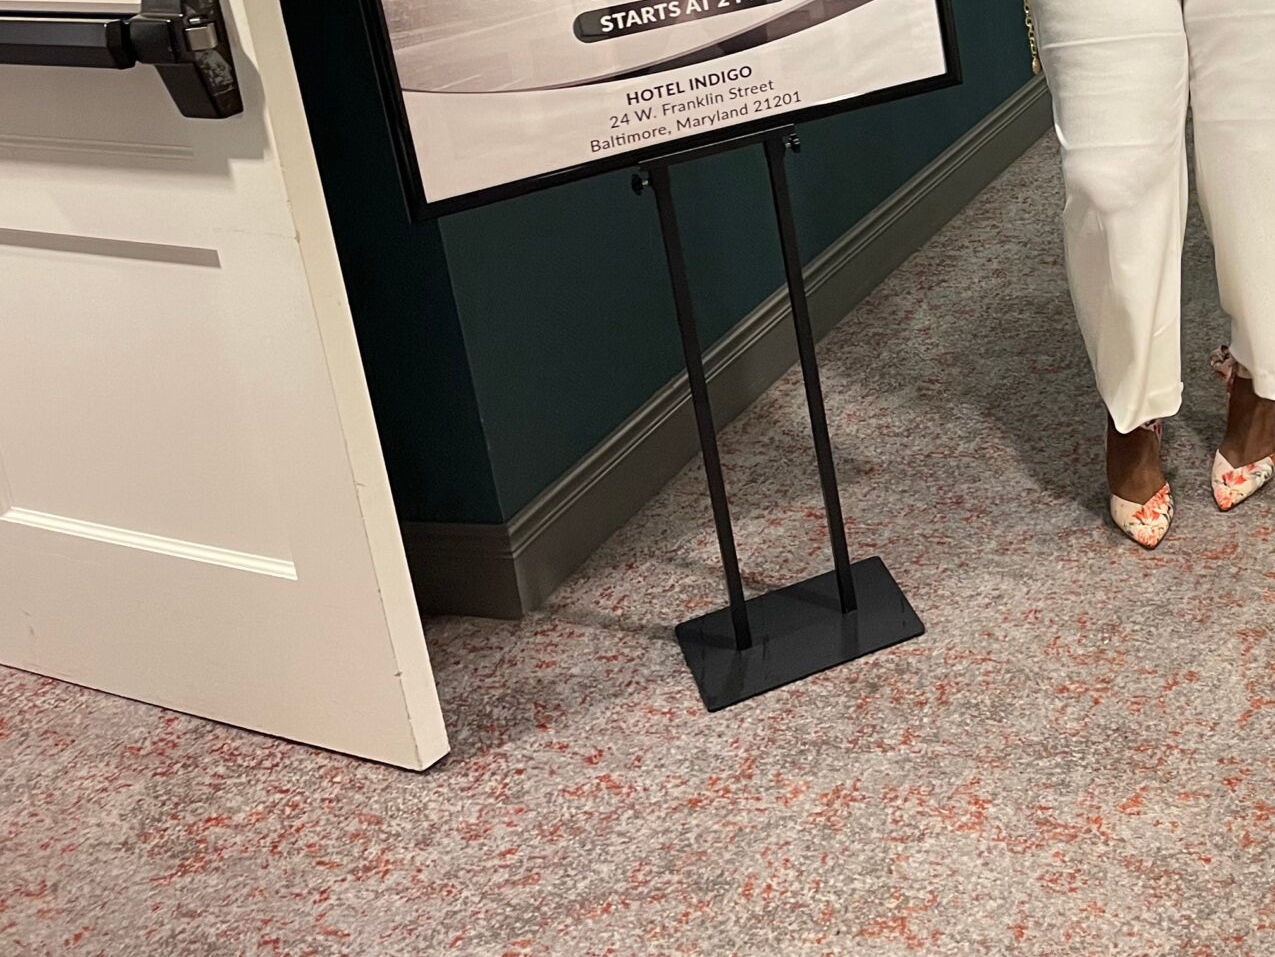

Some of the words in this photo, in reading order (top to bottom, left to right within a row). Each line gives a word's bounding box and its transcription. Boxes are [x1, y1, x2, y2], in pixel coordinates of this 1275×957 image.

[600, 1, 681, 33] STARTS
[609, 115, 631, 129] 24
[634, 106, 657, 122] W.
[662, 93, 724, 117] Franklin
[728, 79, 775, 101] Street
[626, 81, 686, 106] HOTEL
[688, 65, 753, 91] INDIGO
[590, 124, 672, 153] Baltimore,
[676, 105, 750, 132] Maryland
[753, 91, 802, 113] 21201
